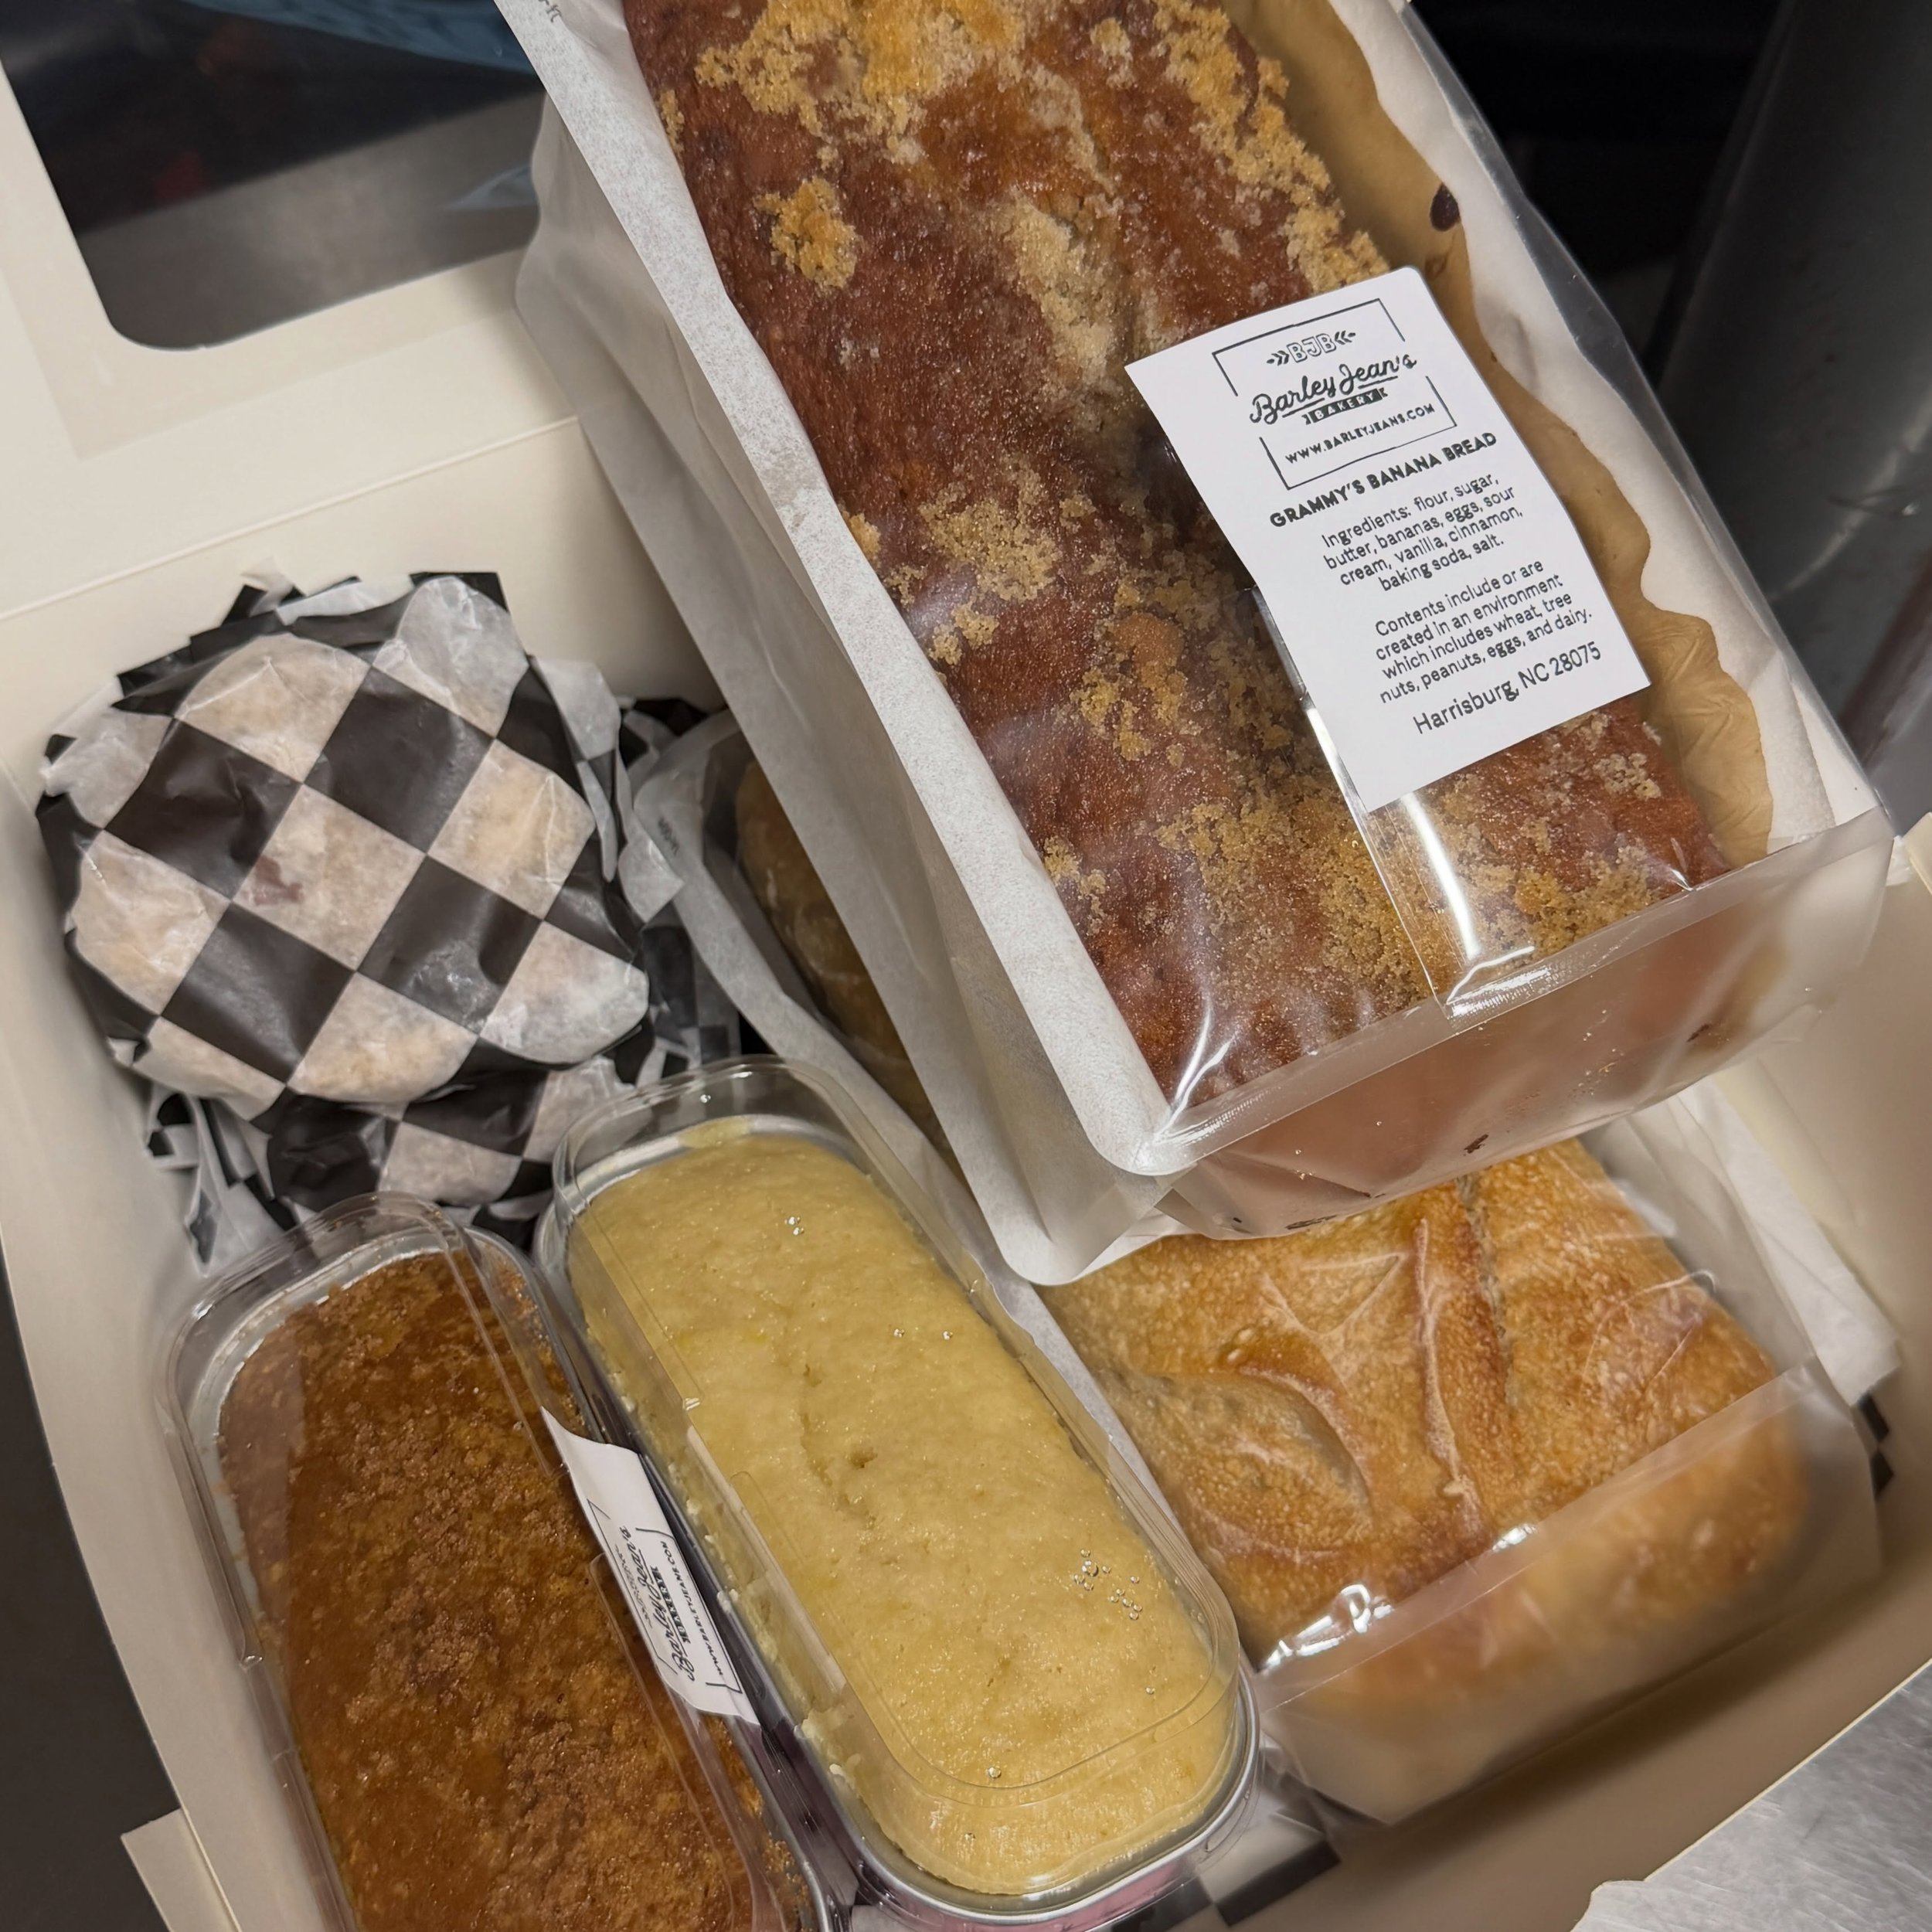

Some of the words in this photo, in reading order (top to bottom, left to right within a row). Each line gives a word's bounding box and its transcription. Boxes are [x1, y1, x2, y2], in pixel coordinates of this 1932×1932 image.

[1287, 333, 1336, 363] BJB
[1250, 376, 1335, 423] Barley
[1338, 354, 1417, 395] Jean's
[1313, 391, 1375, 420] BAKERY
[1285, 403, 1435, 464] WWW.BARLEYJEANS.COM
[1270, 479, 1365, 528] GRAMMY'S
[1366, 454, 1442, 489] BANANA
[1442, 432, 1497, 461] BREAD
[1321, 505, 1411, 547] Ingredients:
[1414, 491, 1454, 512] flour,
[1454, 473, 1498, 497] sugar,
[1323, 541, 1378, 570] butter,
[1376, 516, 1444, 549] bananas,
[1445, 501, 1482, 522] eggs,
[1483, 486, 1515, 507] sour
[1340, 559, 1392, 586] cream,
[1394, 535, 1447, 563] vanilla,
[1449, 506, 1522, 542] cinnamon,
[1379, 563, 1432, 591] baking
[1432, 548, 1471, 570] soda,
[1472, 533, 1504, 555] salt.
[1375, 600, 1446, 636] Contents
[1445, 577, 1501, 608] include
[1502, 570, 1516, 585] or
[1519, 560, 1543, 577] are
[1376, 624, 1434, 661] created
[1433, 621, 1451, 637] in
[1451, 612, 1471, 629] an
[1473, 573, 1563, 620] environment
[1382, 651, 1430, 679] which
[1428, 624, 1493, 660] includes
[1494, 604, 1543, 633] wheat,
[1543, 593, 1572, 612] tree
[1379, 679, 1420, 703] nuts,
[1420, 650, 1485, 689] peanuts,
[1487, 634, 1526, 658] eggs,
[1526, 619, 1553, 641] and
[1554, 607, 1592, 630] dairy.
[1413, 679, 1519, 734] Harrisburg,
[1518, 662, 1549, 689] NC
[1549, 641, 1600, 676] 28075
[649, 1594, 695, 1681] Barley
